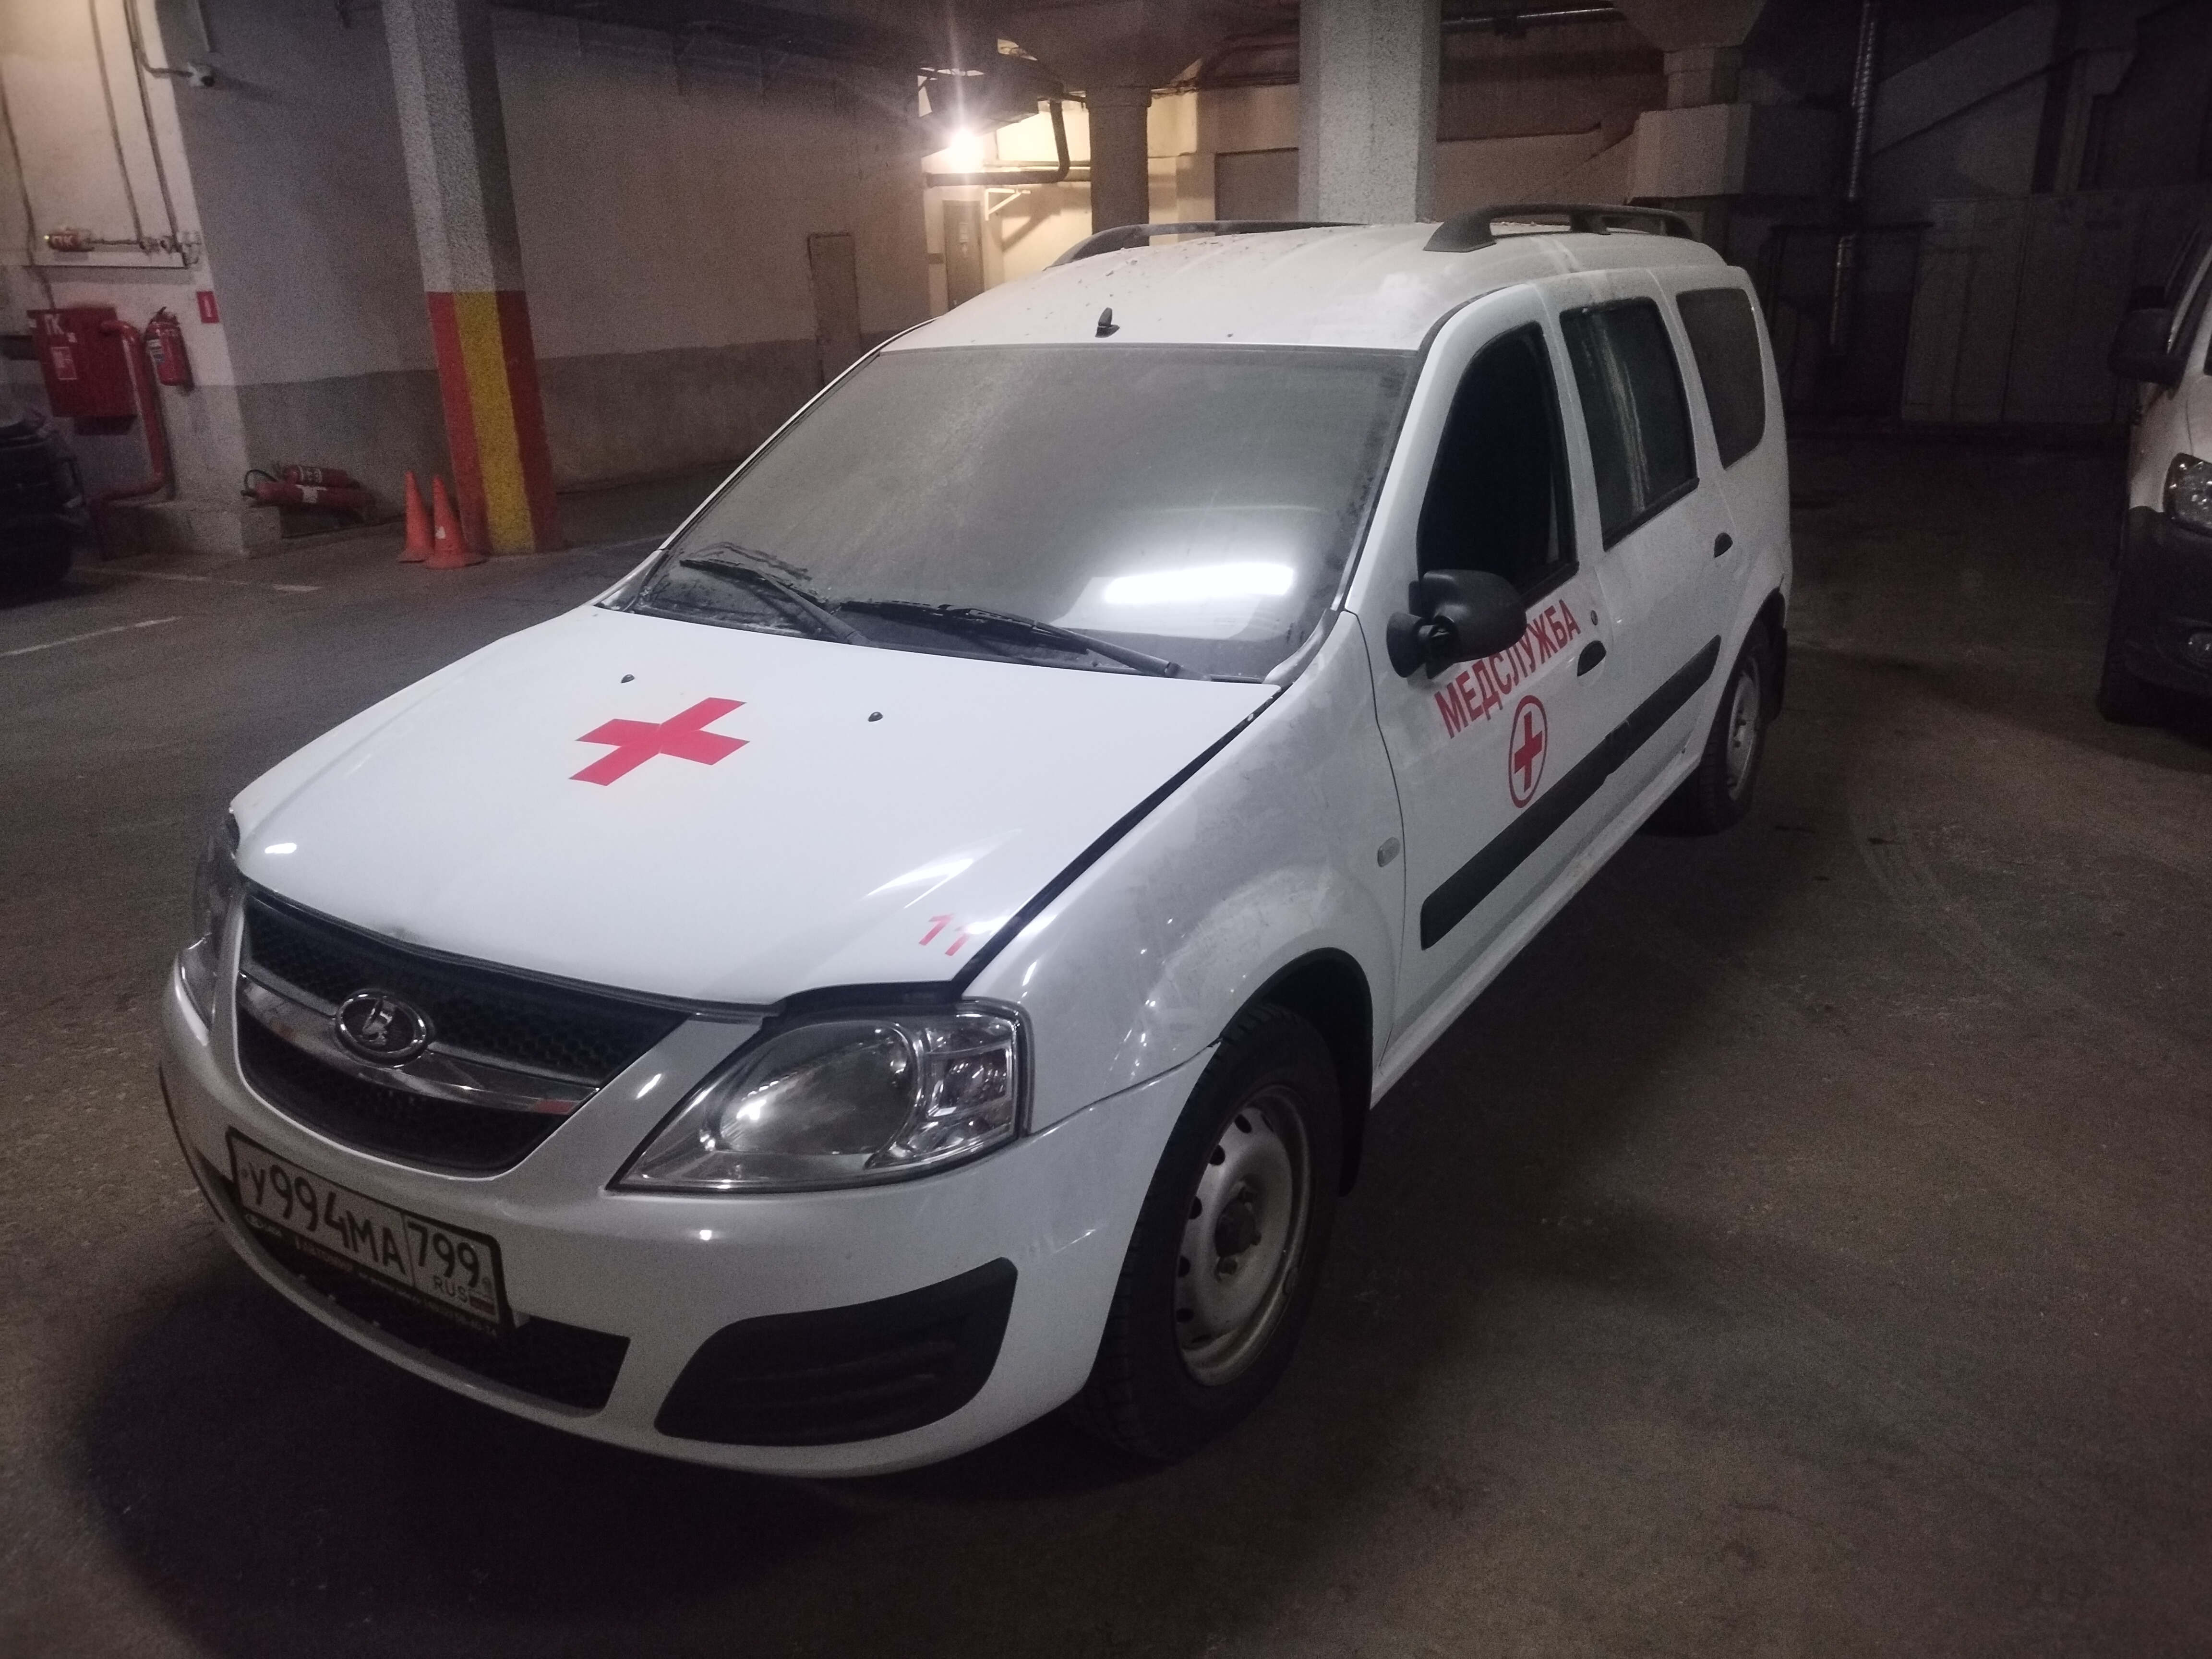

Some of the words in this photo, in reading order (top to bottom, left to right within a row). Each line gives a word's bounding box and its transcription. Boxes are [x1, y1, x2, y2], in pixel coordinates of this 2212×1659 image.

[1434, 599, 1581, 739] МЕДСЛУЖБА
[408, 1220, 480, 1288] 799
[433, 1275, 468, 1303] RUS
